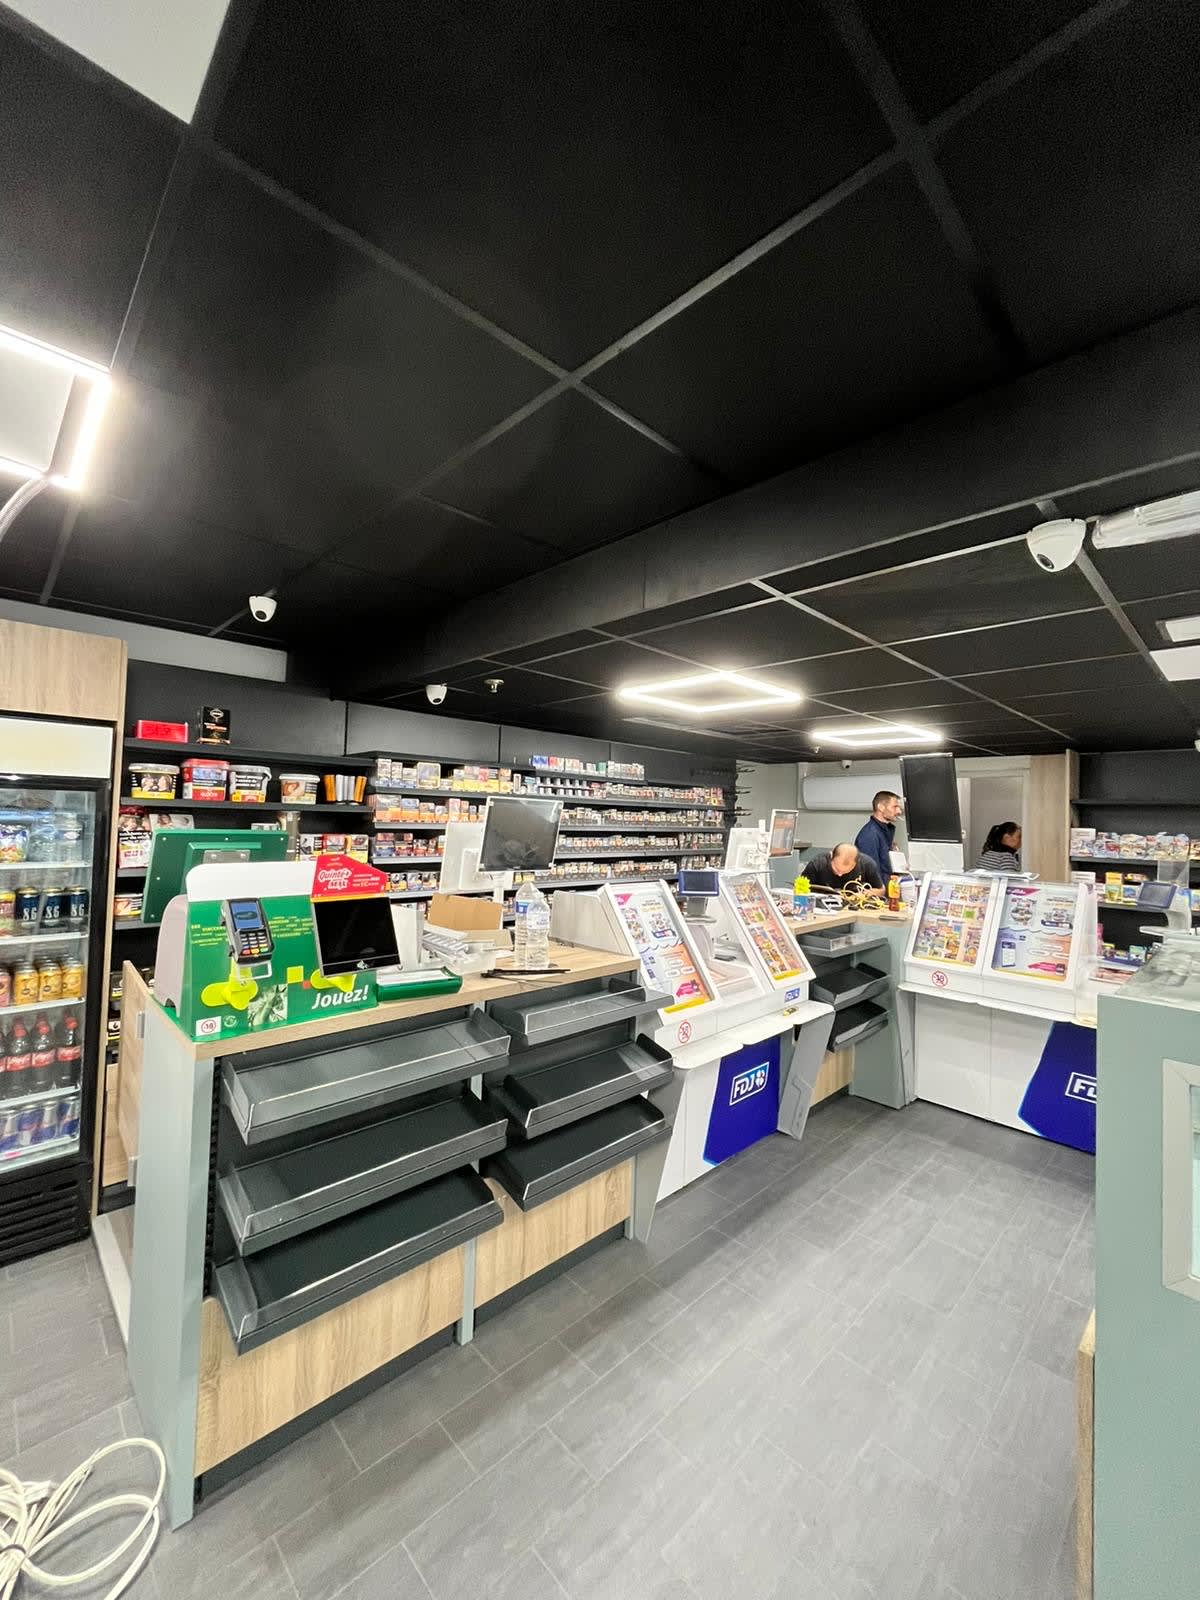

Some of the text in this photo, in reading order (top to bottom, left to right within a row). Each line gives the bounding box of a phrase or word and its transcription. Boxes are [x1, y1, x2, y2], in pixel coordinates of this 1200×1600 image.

[311, 984, 369, 1010] Jouez!
[733, 1073, 755, 1098] FDJ
[1073, 1078, 1097, 1098] FD
